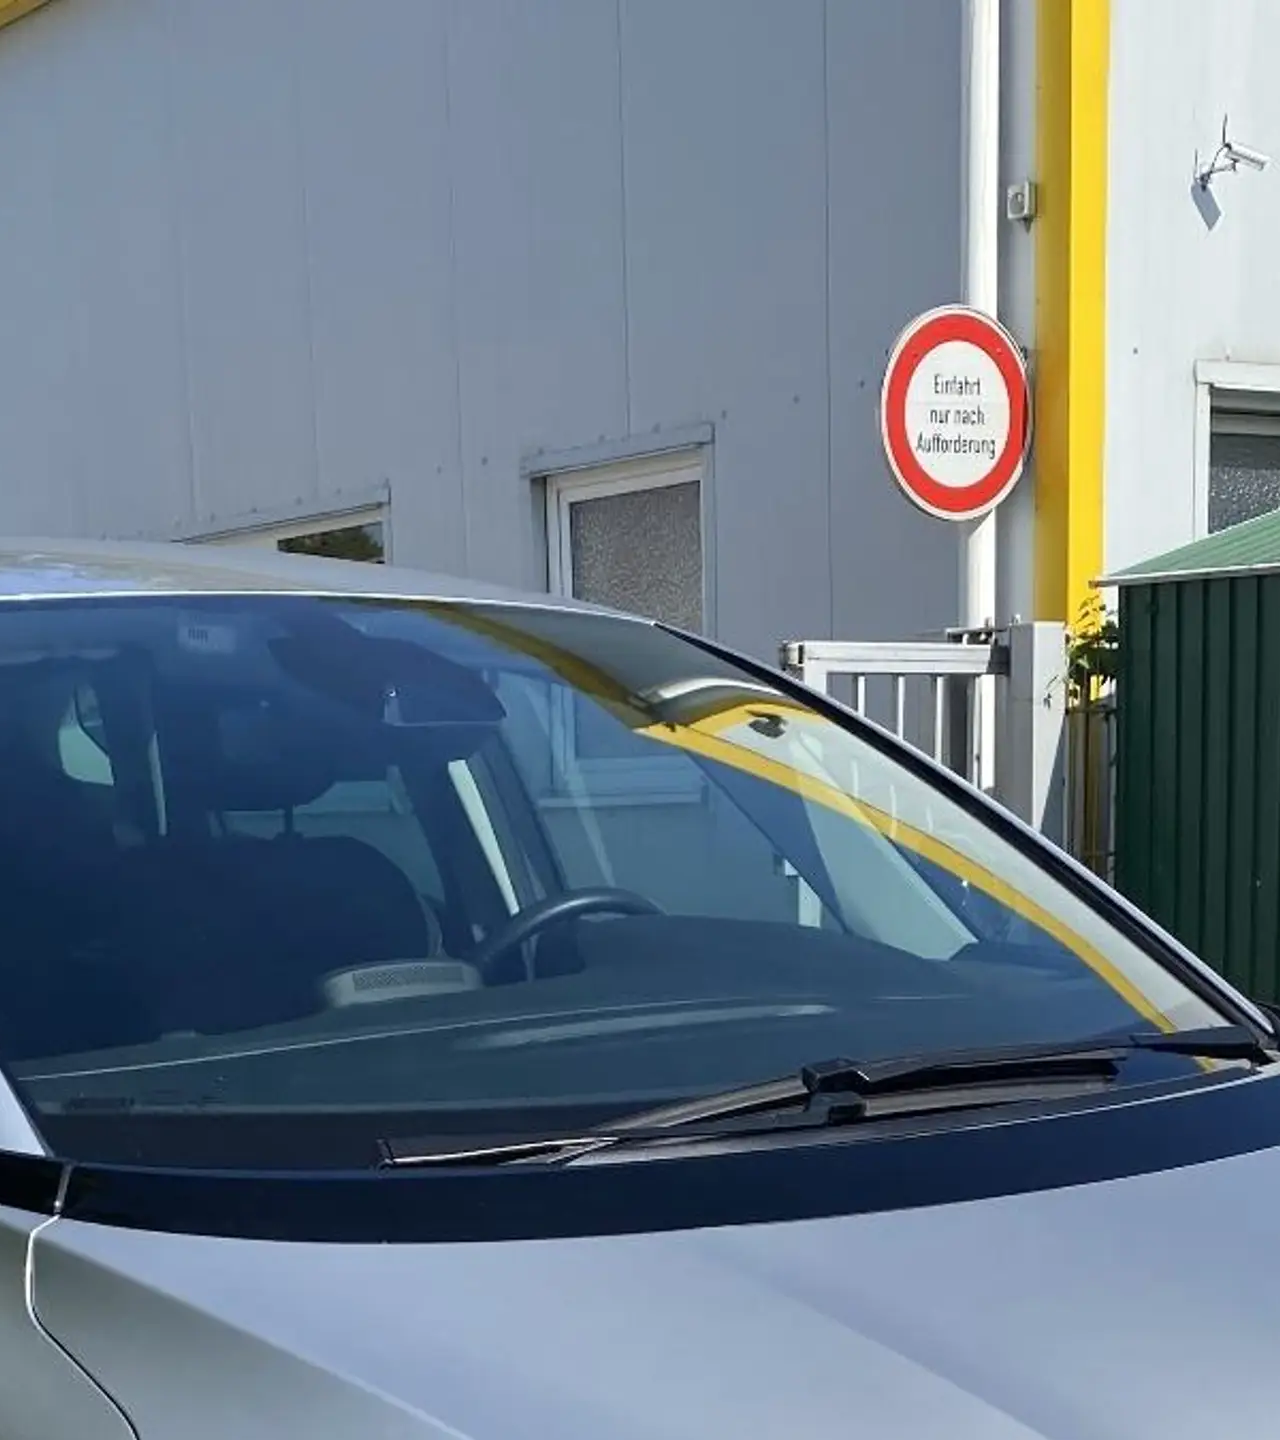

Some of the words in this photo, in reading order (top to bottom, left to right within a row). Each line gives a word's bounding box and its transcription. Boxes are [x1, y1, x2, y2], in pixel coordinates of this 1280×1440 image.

[934, 373, 981, 396] Einfahrt
[929, 408, 951, 425] nur
[953, 406, 985, 426] nach
[916, 433, 996, 459] Aufforderung
